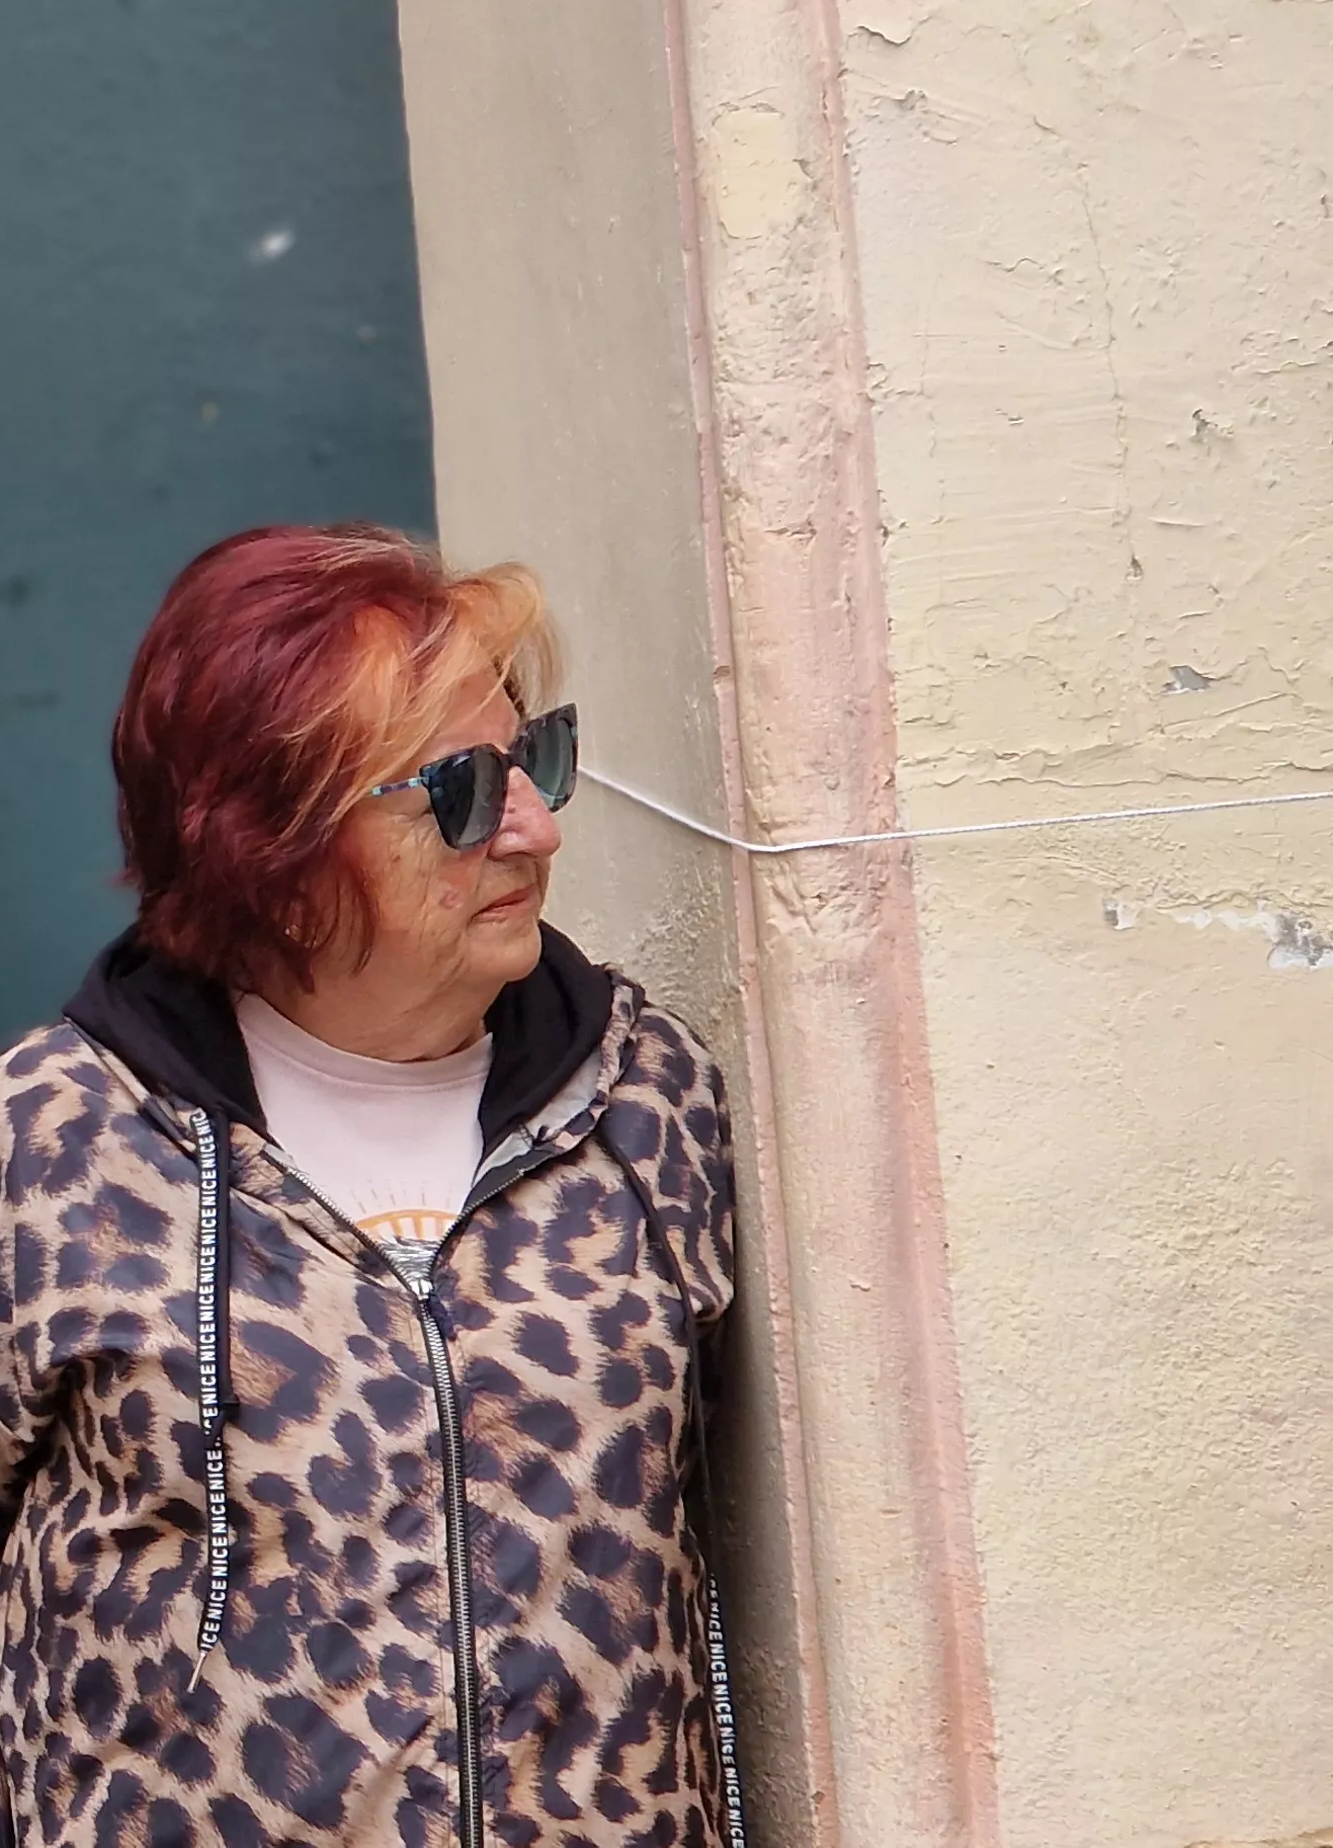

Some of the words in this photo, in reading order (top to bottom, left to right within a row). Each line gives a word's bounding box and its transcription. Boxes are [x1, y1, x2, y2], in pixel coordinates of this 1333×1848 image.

[198, 1135, 216, 1168] NICE
[201, 1169, 217, 1206] NICE
[200, 1208, 217, 1245] NICE
[199, 1246, 216, 1284] NICE
[199, 1284, 215, 1322] NICE
[199, 1323, 216, 1362] NICE
[200, 1364, 218, 1405] NICE
[206, 1450, 225, 1490] NICE
[209, 1493, 227, 1534] NICE
[211, 1536, 228, 1577] NICE
[206, 1579, 227, 1620] NICE
[709, 1643, 728, 1683] NICE
[713, 1683, 734, 1724] NICE
[719, 1726, 736, 1765] NICE
[724, 1767, 741, 1807] NICE
